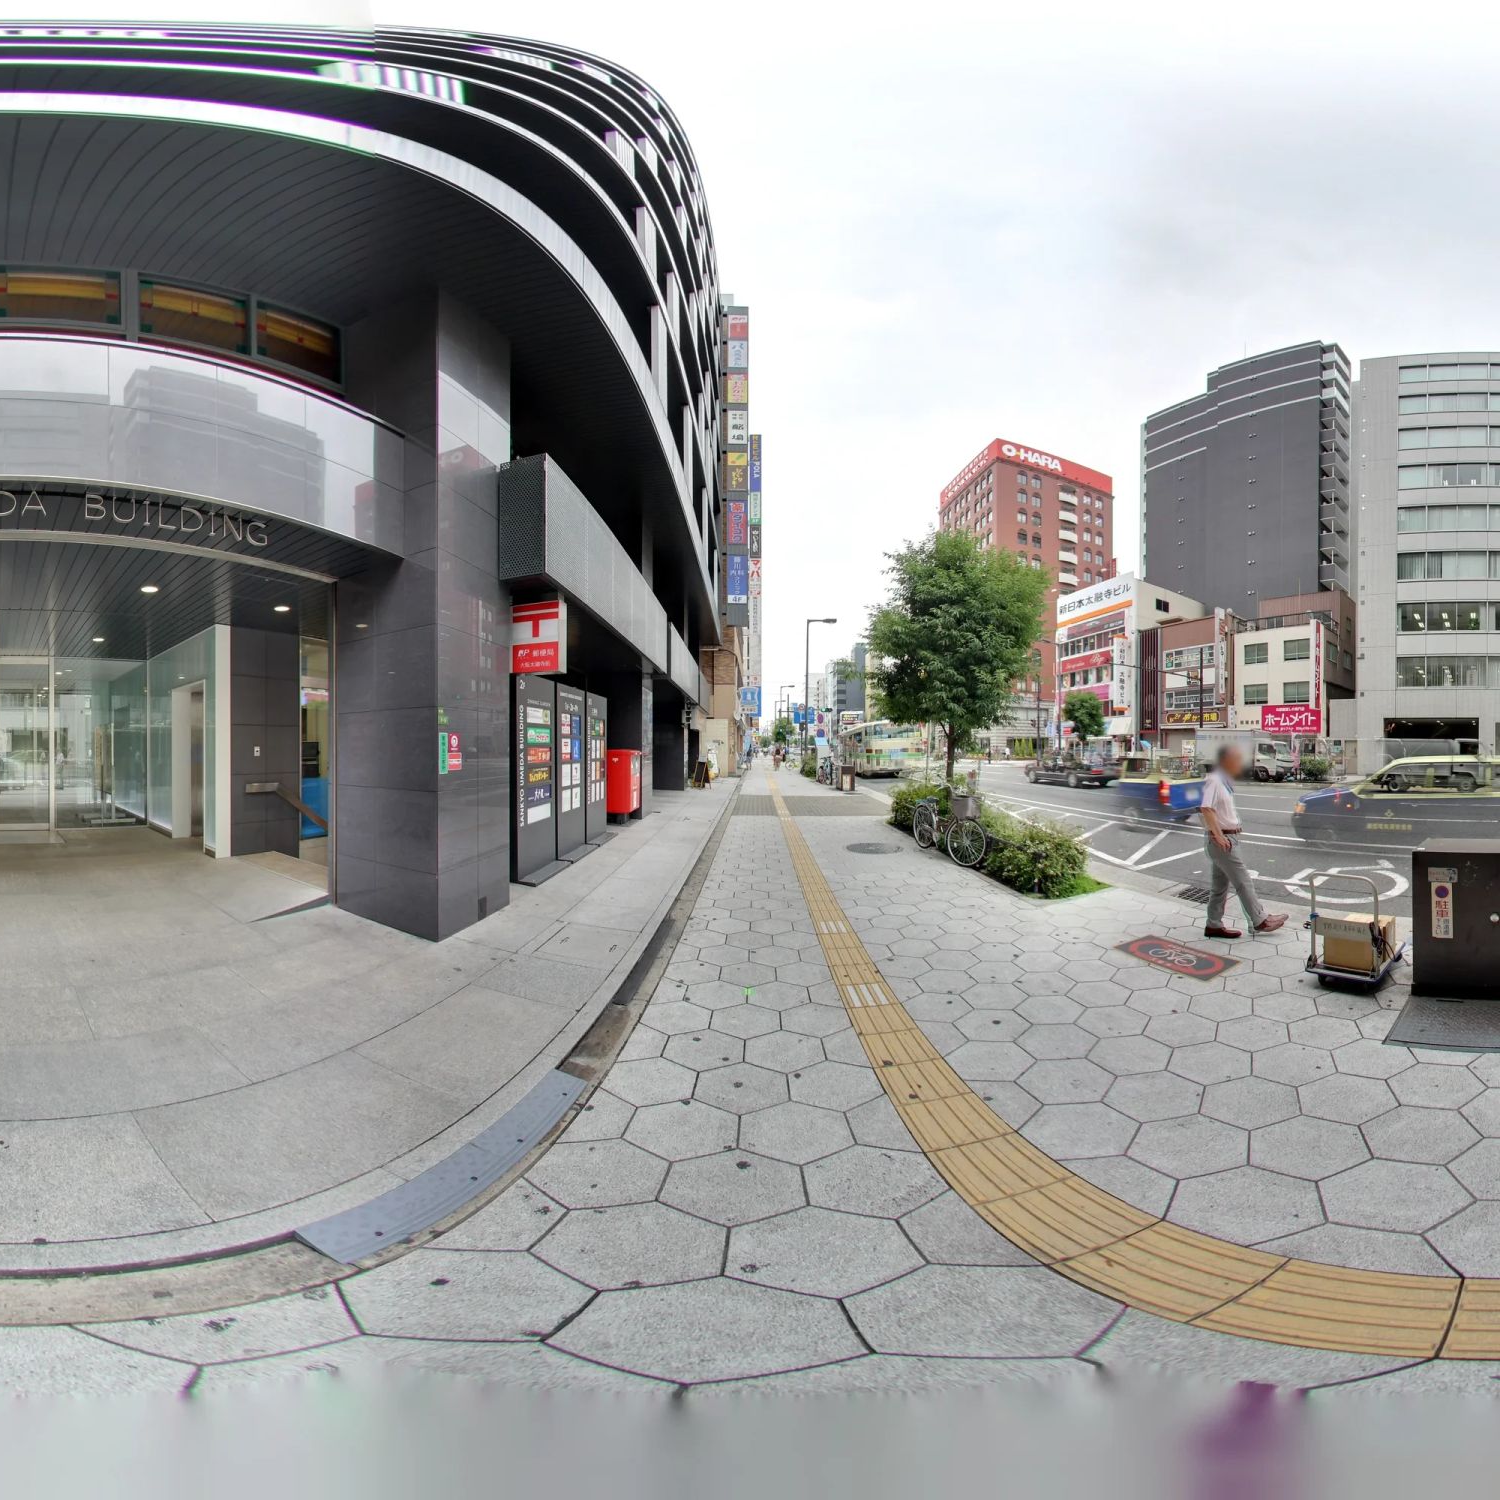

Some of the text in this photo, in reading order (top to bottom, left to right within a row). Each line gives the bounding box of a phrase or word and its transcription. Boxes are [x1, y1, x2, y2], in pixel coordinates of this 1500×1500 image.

[1002, 444, 1062, 472] O-HARA
[84, 494, 269, 546] BUILDING
[1059, 583, 1132, 615] 新日本太融寺ビル
[1264, 712, 1317, 726] ホームメイト
